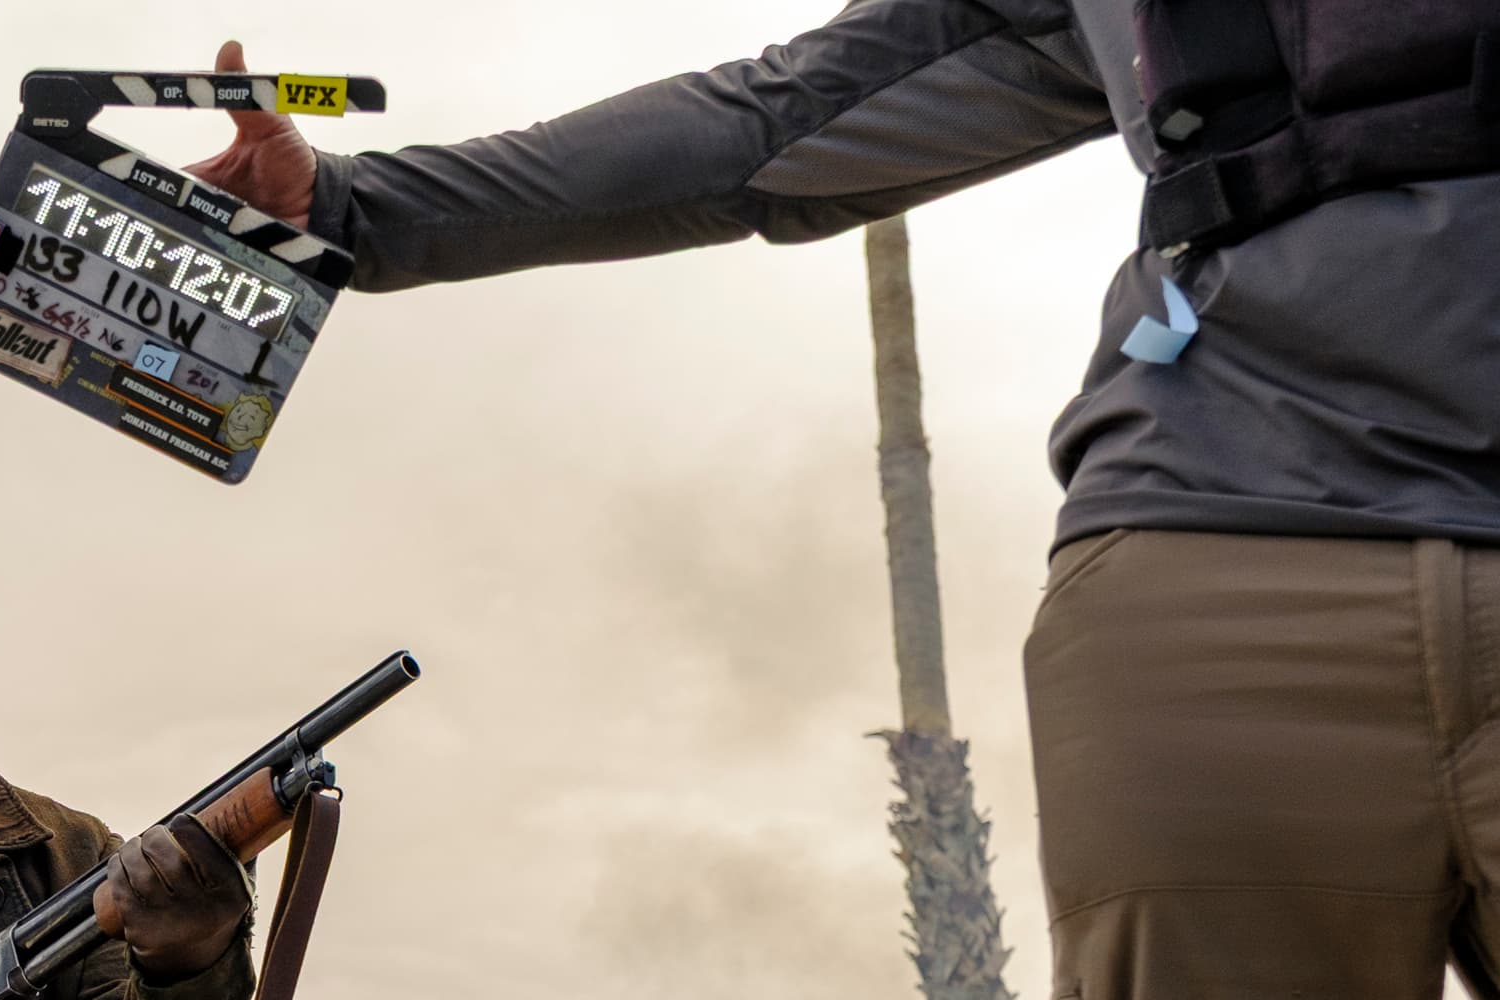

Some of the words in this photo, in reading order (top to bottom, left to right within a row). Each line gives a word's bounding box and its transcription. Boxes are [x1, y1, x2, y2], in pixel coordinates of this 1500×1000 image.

[163, 86, 183, 99] OP:
[218, 87, 250, 101] SOUP
[284, 83, 338, 108] VFX
[131, 168, 157, 187] 1ST
[156, 177, 177, 197] AC:
[190, 194, 232, 225] WOLFE
[26, 179, 293, 328] 11:10:12:07
[102, 269, 207, 349] 110W
[141, 353, 166, 372] 07
[186, 369, 220, 395] 201
[121, 376, 169, 406] FREDERICK
[187, 407, 212, 427] TOYE
[121, 413, 170, 441] JONATHAN
[168, 435, 211, 462] FREEMAN
